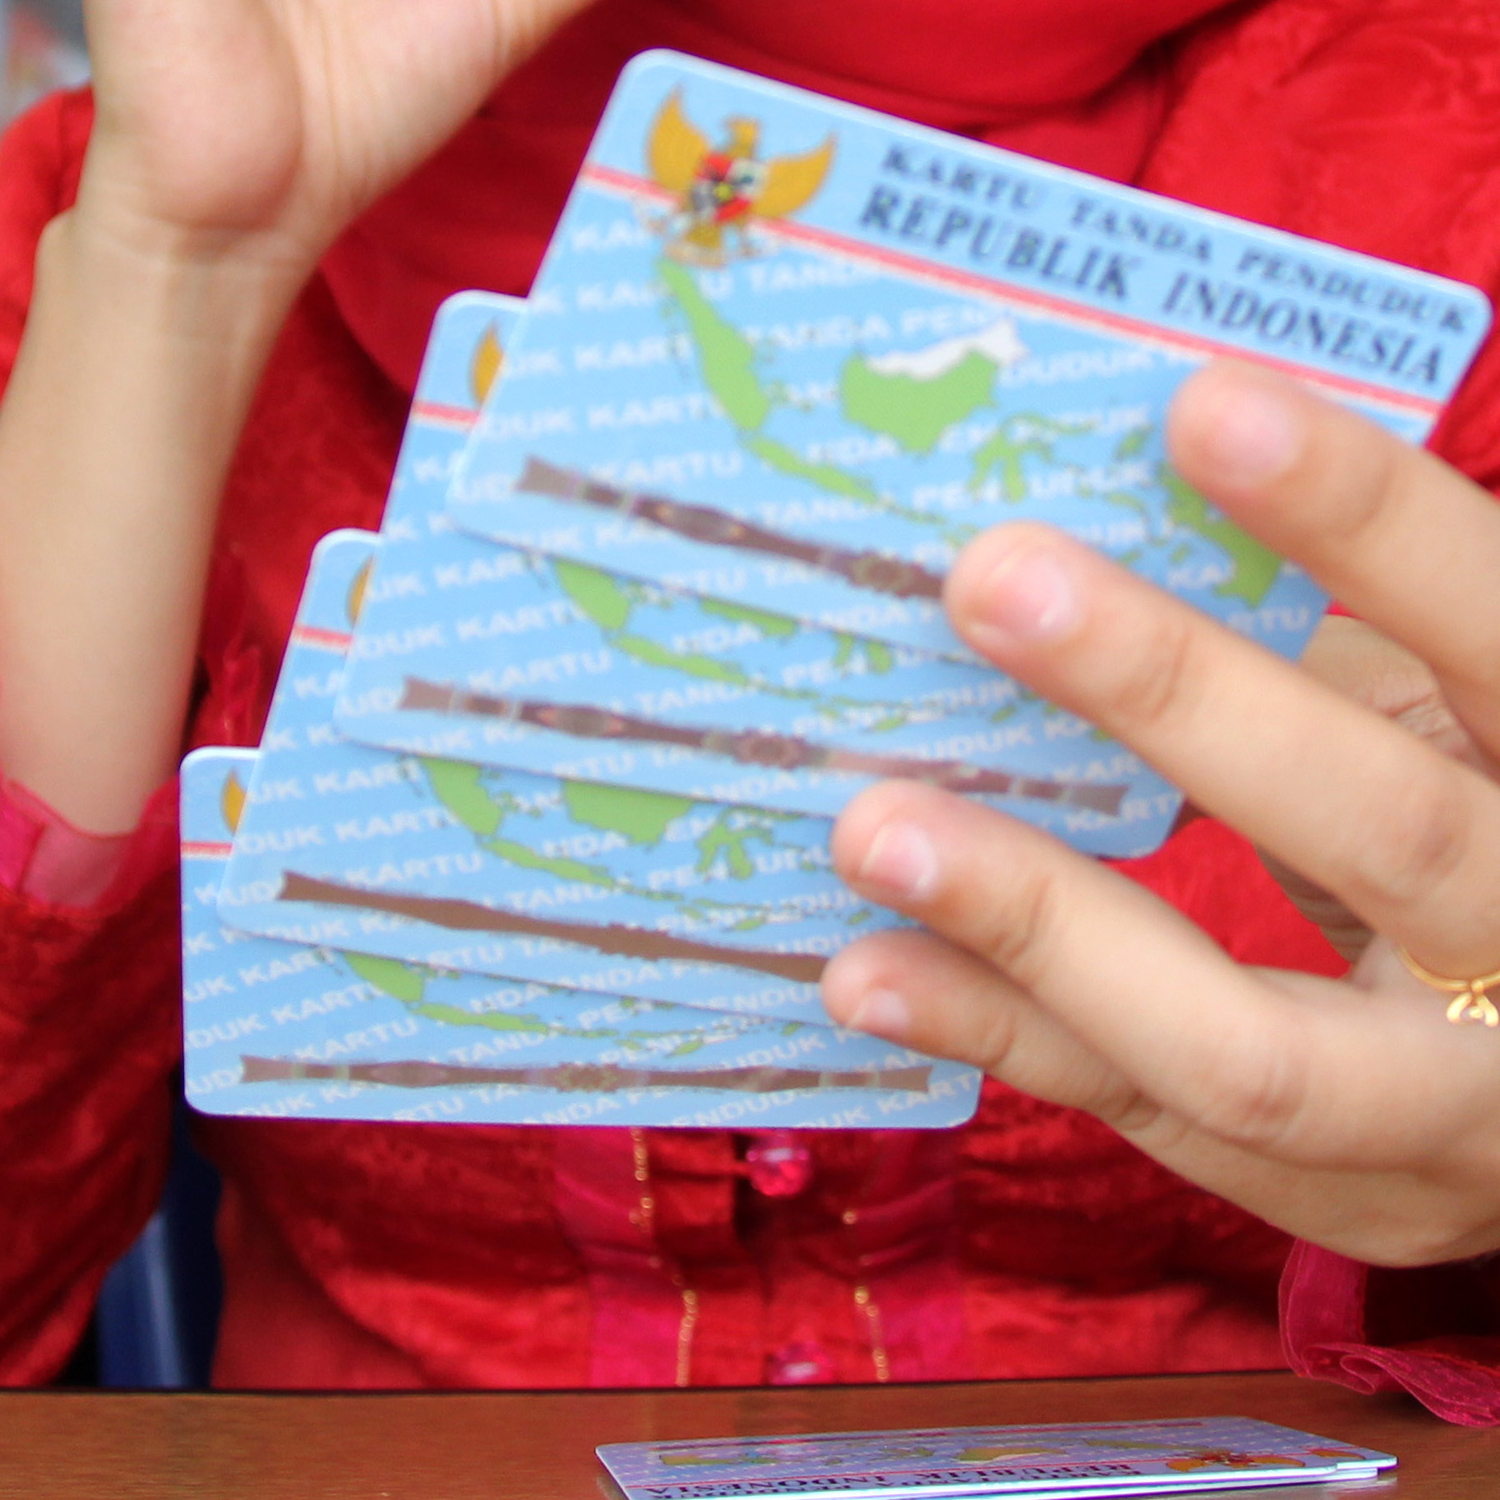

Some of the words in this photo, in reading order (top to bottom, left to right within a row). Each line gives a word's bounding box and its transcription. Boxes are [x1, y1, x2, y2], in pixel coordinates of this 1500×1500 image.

[859, 184, 1142, 299] REPUBLIK
[1161, 270, 1445, 385] INDONESIA
[882, 144, 1042, 210] KARTU
[1070, 196, 1214, 261] TANDA
[1236, 245, 1469, 333] PENDUDUK
[644, 1474, 888, 1495] INDONESIA
[916, 1463, 1134, 1480] REPUBLIK
